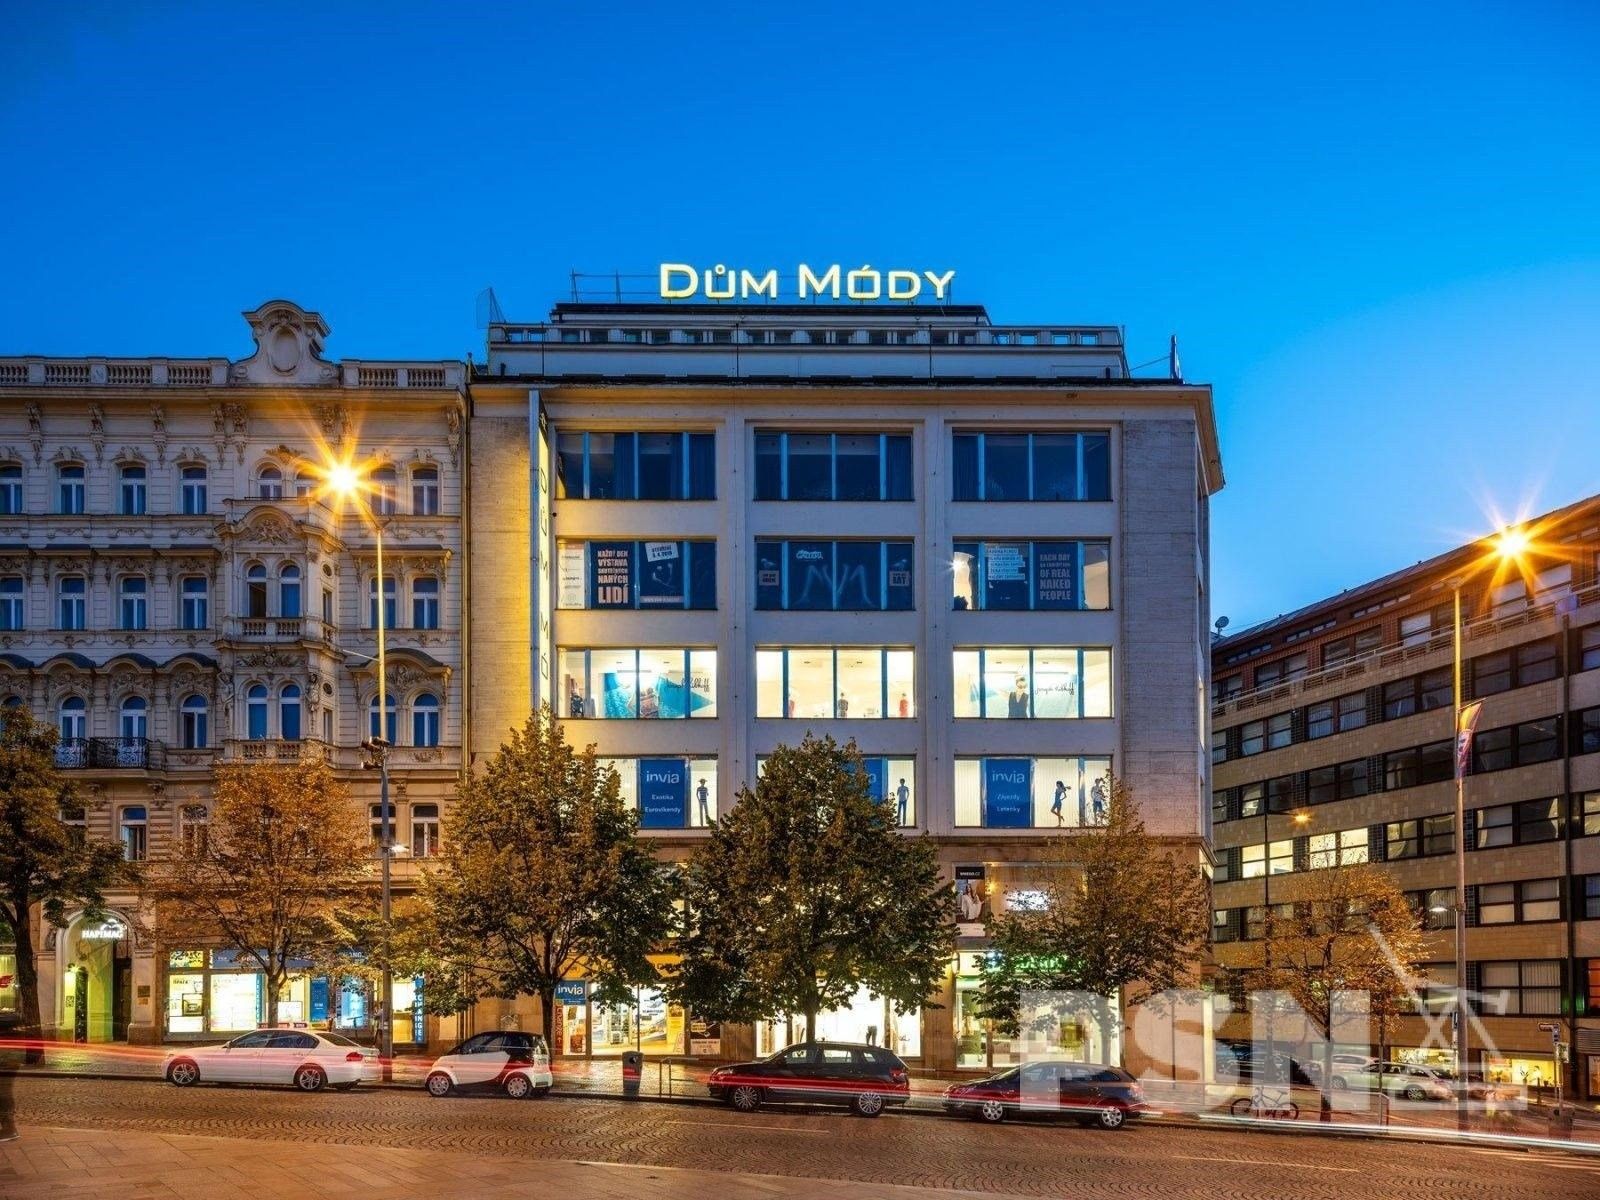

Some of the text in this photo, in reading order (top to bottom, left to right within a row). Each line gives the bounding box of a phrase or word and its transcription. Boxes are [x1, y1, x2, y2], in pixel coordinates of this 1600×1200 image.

[597, 558, 628, 567] VÝSTAVA
[1040, 553, 1070, 561] EACH DAY
[1040, 579, 1071, 590] NAKED
[597, 584, 629, 604] LIDÍ
[1040, 590, 1071, 600] PEOPLE
[646, 770, 680, 784] invia
[992, 770, 1025, 784] invia
[557, 984, 584, 996] invia
